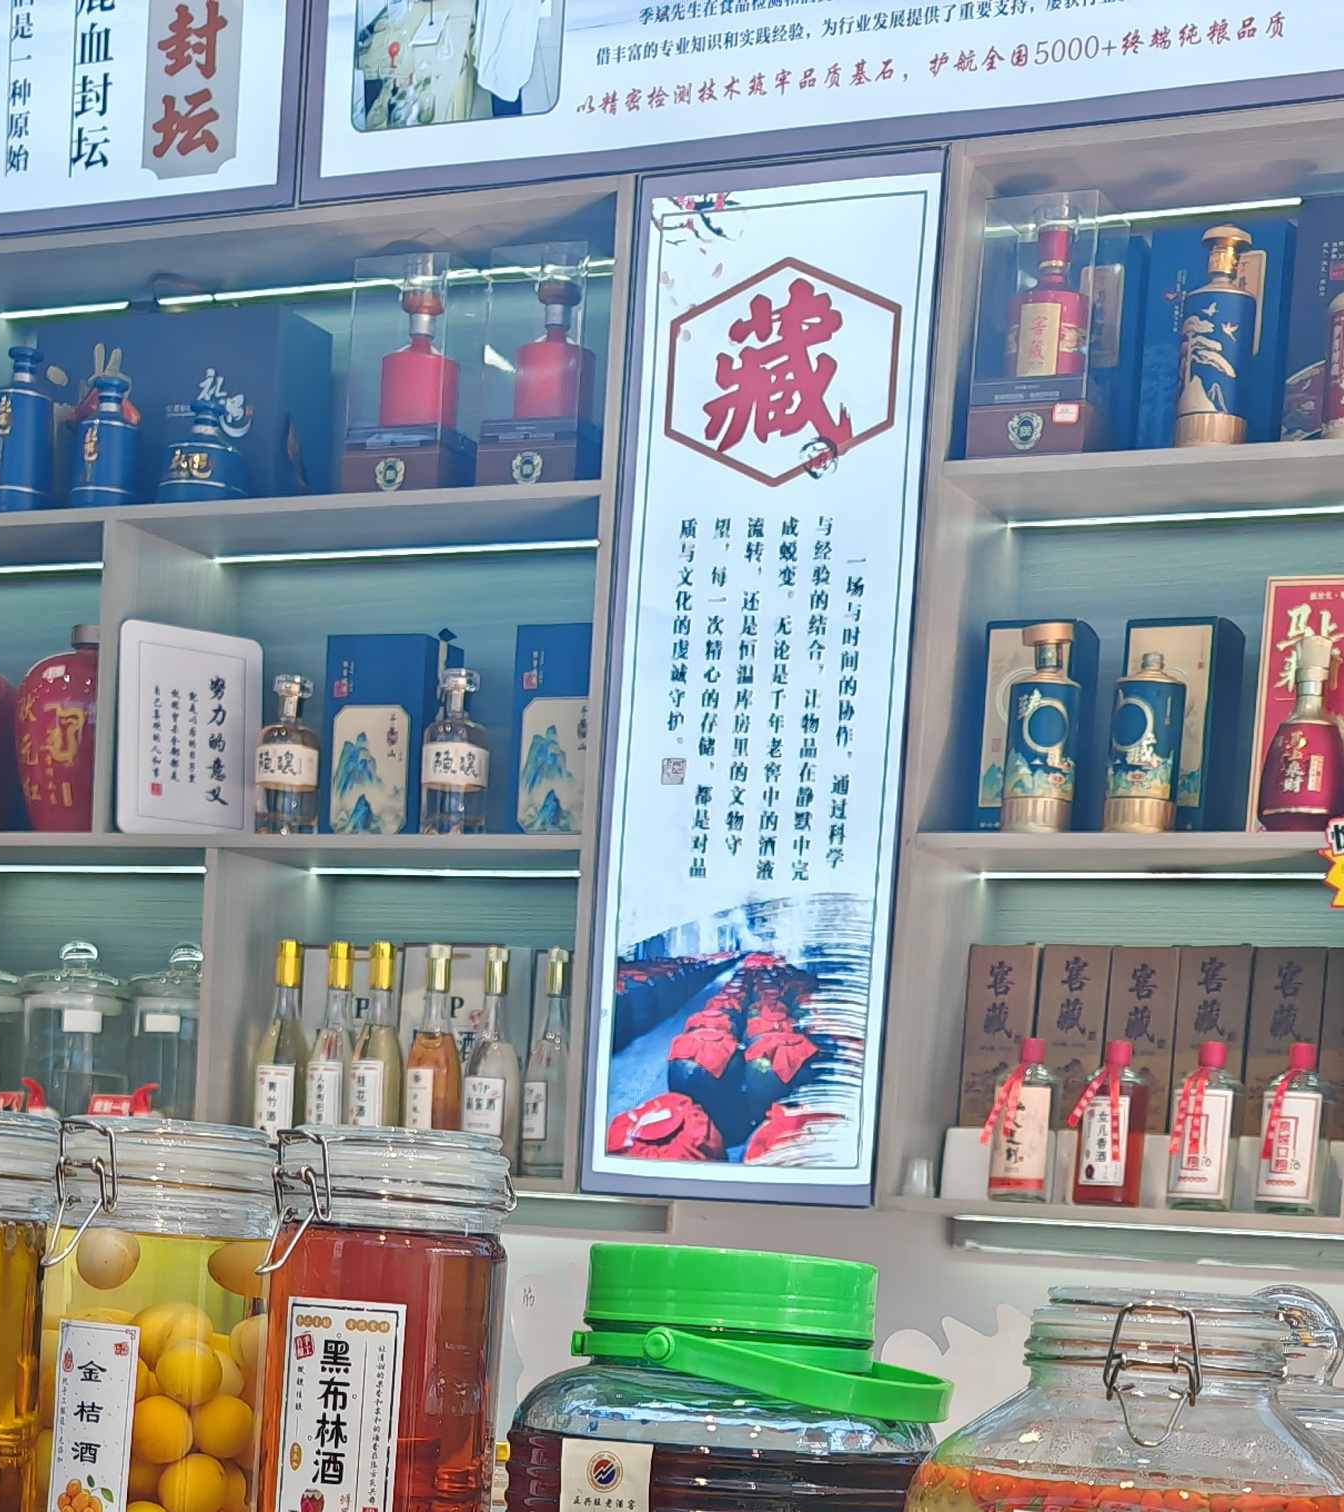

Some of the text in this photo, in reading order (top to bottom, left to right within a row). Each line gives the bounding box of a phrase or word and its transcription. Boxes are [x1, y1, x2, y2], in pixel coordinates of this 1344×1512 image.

[6, 0, 33, 173] 是一种原始
[152, 0, 227, 158] 封坛
[703, 279, 852, 452] 藏
[206, 675, 228, 806] 努力的意义
[826, 558, 866, 870] 一场与时间的协作，通过科学
[72, 1360, 108, 1465] 金桔酒
[312, 1339, 352, 1485] 黑布林酒
